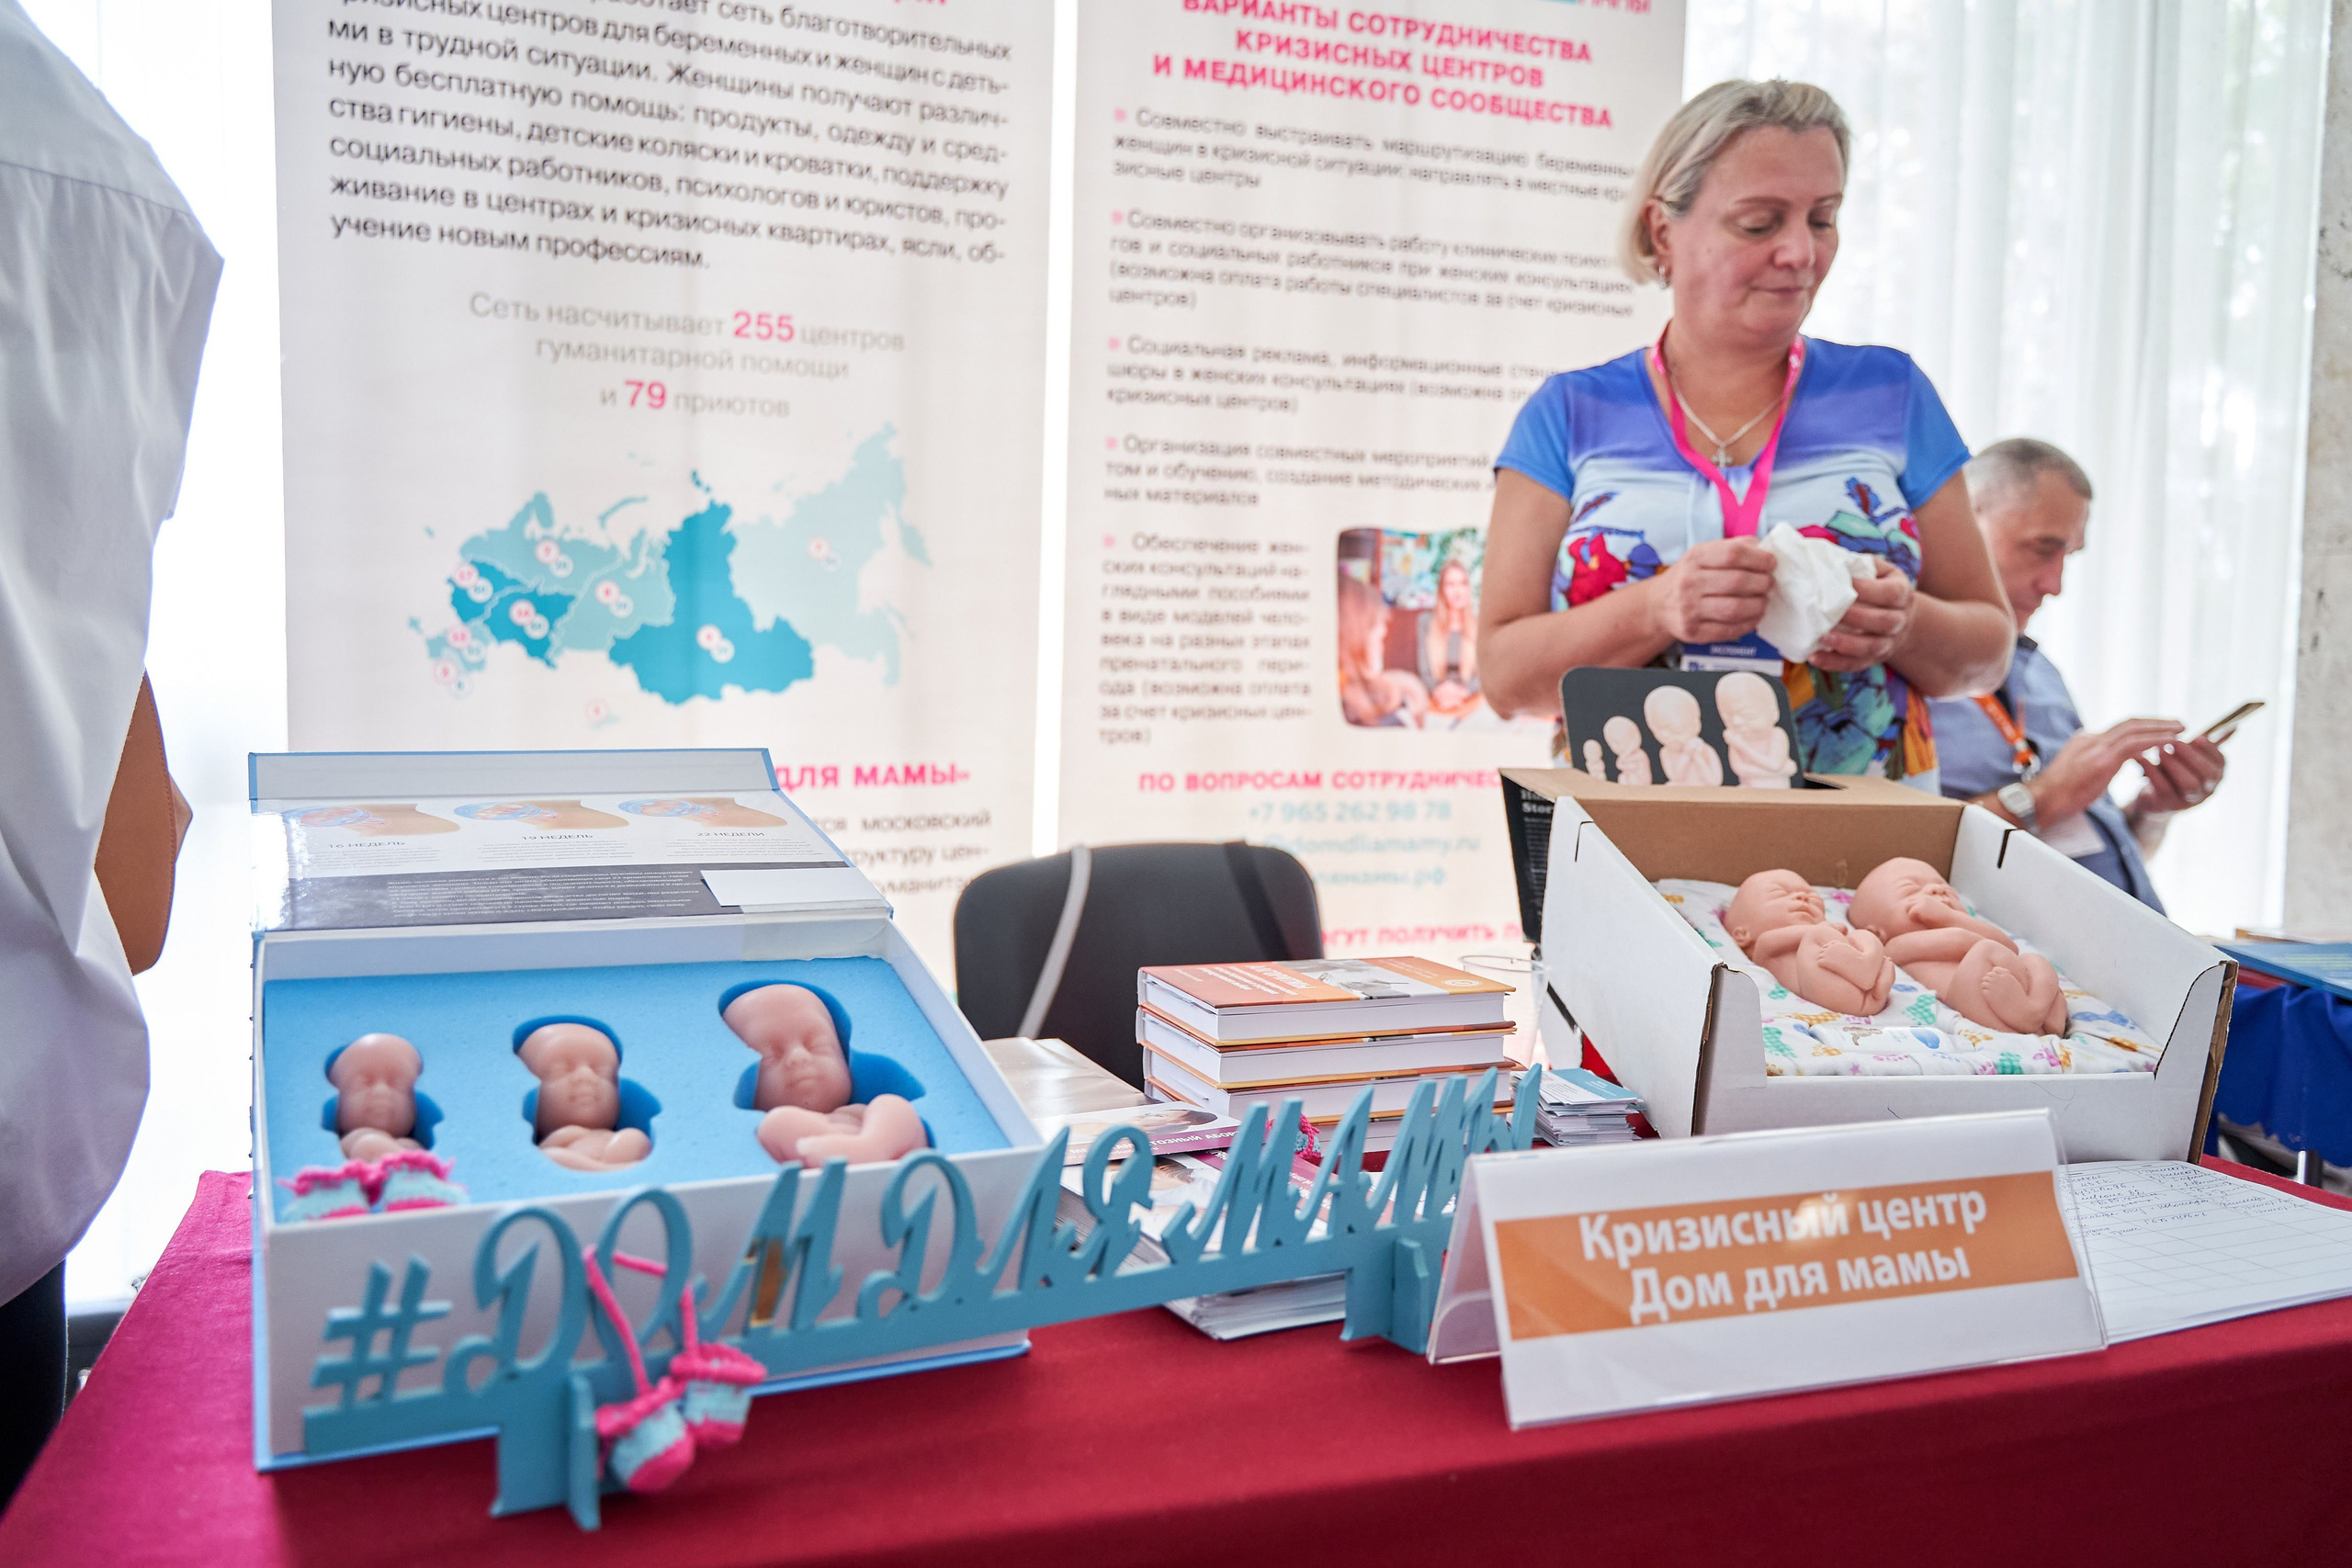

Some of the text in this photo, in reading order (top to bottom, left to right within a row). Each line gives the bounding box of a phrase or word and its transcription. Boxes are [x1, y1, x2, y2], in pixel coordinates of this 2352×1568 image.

[487, 4, 599, 37] центров
[602, 20, 650, 43] для
[653, 23, 811, 64] беременных
[816, 53, 831, 67] и
[836, 55, 929, 83] женщин
[933, 70, 944, 86] с
[948, 72, 1007, 94] деть-
[720, 0, 1010, 60] сеть благотворительных
[1183, 0, 1591, 62] ВАРИАНТЫ СОТРУДНИЧЕСТВА
[1236, 29, 1544, 88] КРИЗИСНЫХ ЦЕНТРОВ
[328, 19, 1009, 125] ми в трудной ситуации. Женщины получают различ-
[1153, 54, 1611, 128] И МЕДИЦИНСКОГО СООБЩЕСТВА
[329, 59, 1009, 163] ную бесплатную помощь: продукты, одежду и сред-
[329, 98, 1007, 201] ства гигиены, детские коляски и кроватки, поддержку
[330, 137, 1003, 230] социальных работников, психологов и юристов, про-
[331, 176, 1002, 263] живание в центрах и кризисных квартирах, ясли, об-
[331, 215, 710, 267] учение новым профессиям.
[469, 292, 905, 351] Сеть насчитывает 255 центров
[536, 338, 849, 379] гуманитарной помощи
[601, 379, 788, 414] и 79 приютов
[778, 766, 839, 795] ДЛЯ
[1139, 773, 1175, 792] ПО
[1184, 771, 1323, 792] ВОПРОСАМ
[1521, 801, 1553, 814] Stor
[1579, 1192, 1849, 1269] Кризисный
[1859, 1190, 1986, 1235] центр
[1630, 1246, 1971, 1324] Дом для мамы
